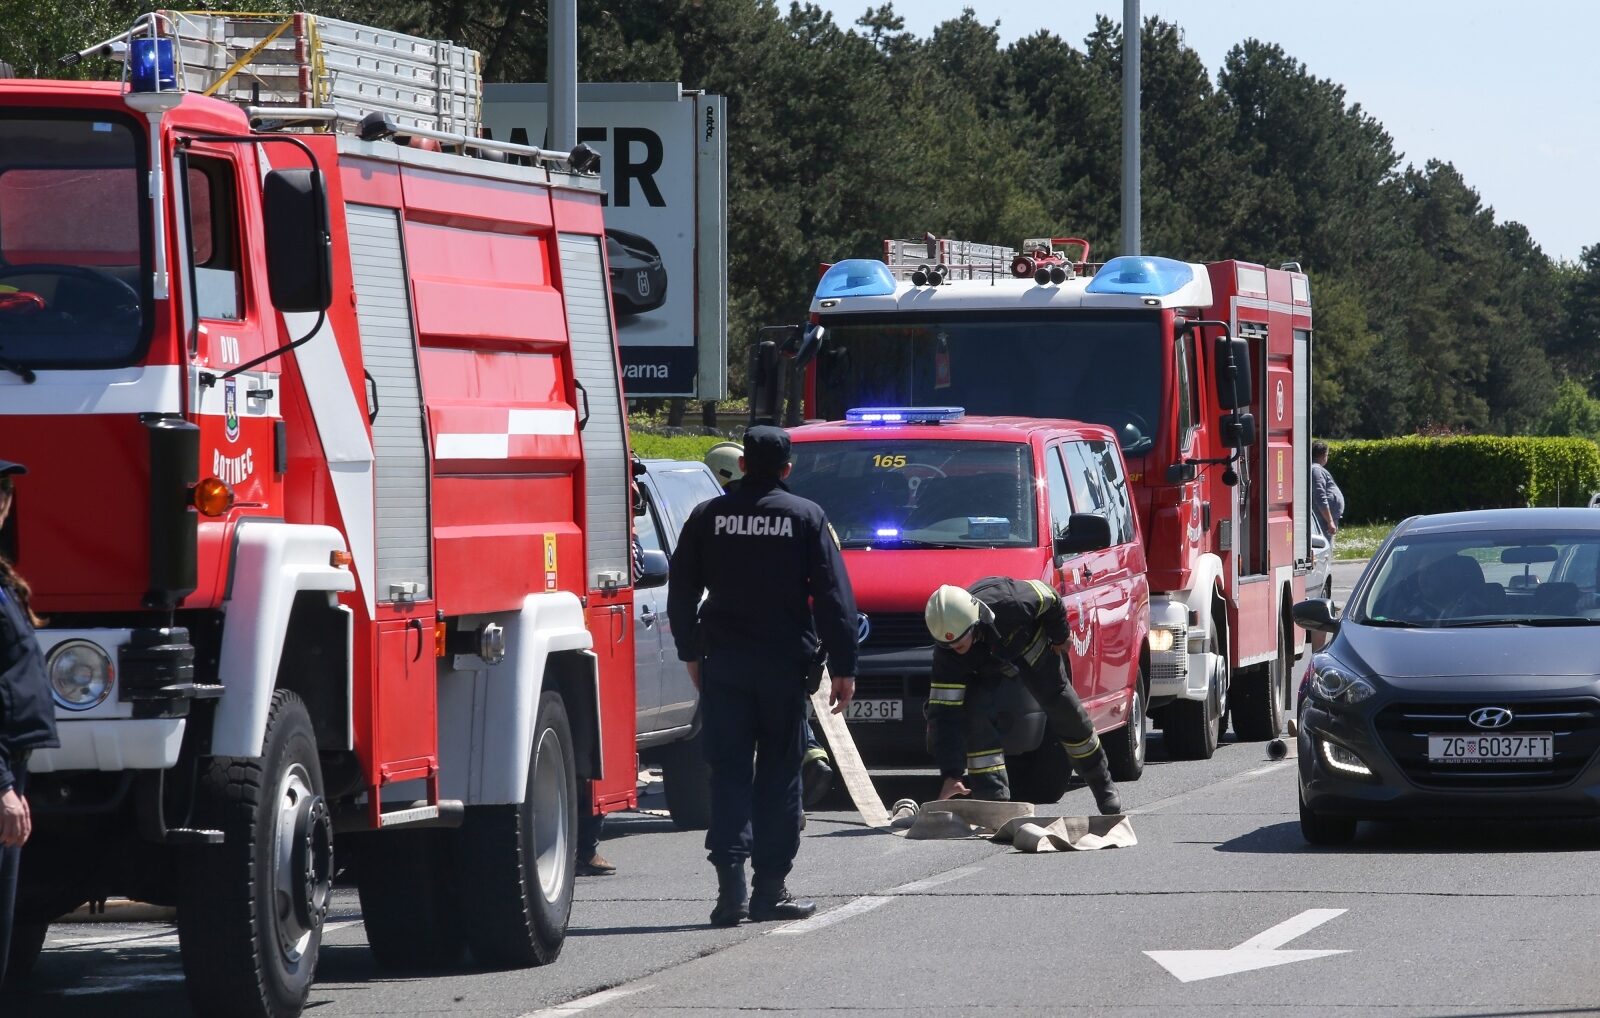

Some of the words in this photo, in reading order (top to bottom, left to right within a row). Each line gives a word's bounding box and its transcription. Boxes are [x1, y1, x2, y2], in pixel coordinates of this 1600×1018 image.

[220, 335, 240, 364] DVD
[212, 447, 254, 485] BOTINEC
[872, 454, 907, 468] 165
[714, 515, 793, 538] POLICIJA
[1443, 737, 1465, 757] ZG
